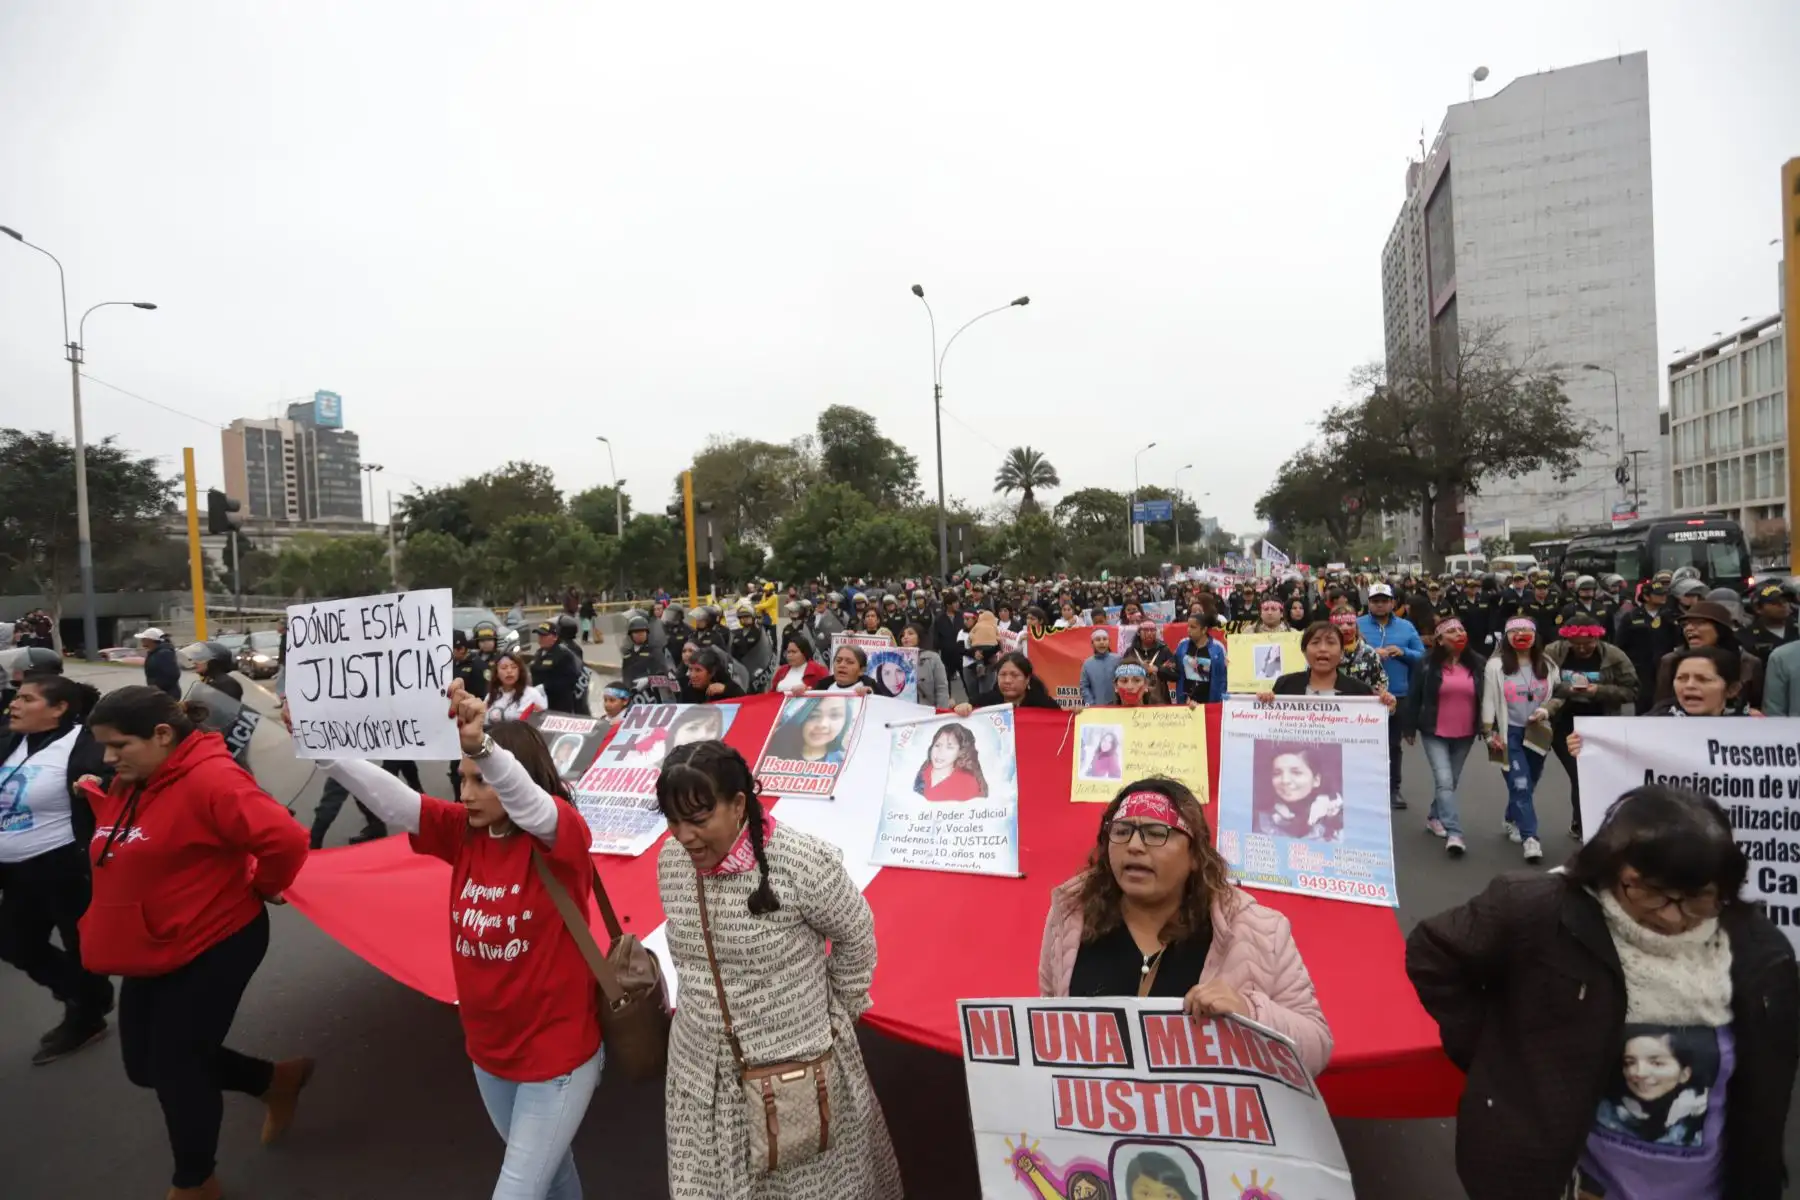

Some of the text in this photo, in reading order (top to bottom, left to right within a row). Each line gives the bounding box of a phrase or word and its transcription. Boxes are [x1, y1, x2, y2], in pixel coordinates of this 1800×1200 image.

[1674, 530, 1726, 538] FINISTERRE
[361, 594, 408, 641] ESTÁ
[417, 604, 441, 641] LA
[297, 644, 453, 701] JUSTICIA?
[623, 705, 677, 729] NO
[1253, 702, 1341, 712] DESAPARECIDA
[543, 716, 596, 733] JUSTICIA
[804, 761, 838, 775] PIDO
[578, 768, 661, 794] FEMINIC
[1759, 774, 1783, 799] de
[887, 808, 1007, 821] Sres. del Poder Judicial
[907, 823, 984, 836] Juez y Vocales
[939, 835, 948, 845] la
[953, 834, 1008, 846] JUSTICIA
[890, 847, 907, 856] que
[935, 847, 947, 857] 10
[951, 849, 975, 859] años
[979, 851, 996, 860] nos
[511, 884, 520, 894] a
[1299, 874, 1387, 897] 949367804
[507, 915, 518, 934] y
[522, 909, 533, 920] a
[968, 1009, 1307, 1088] NI UNA MENOS
[1056, 1078, 1272, 1142] JUSTICIA
